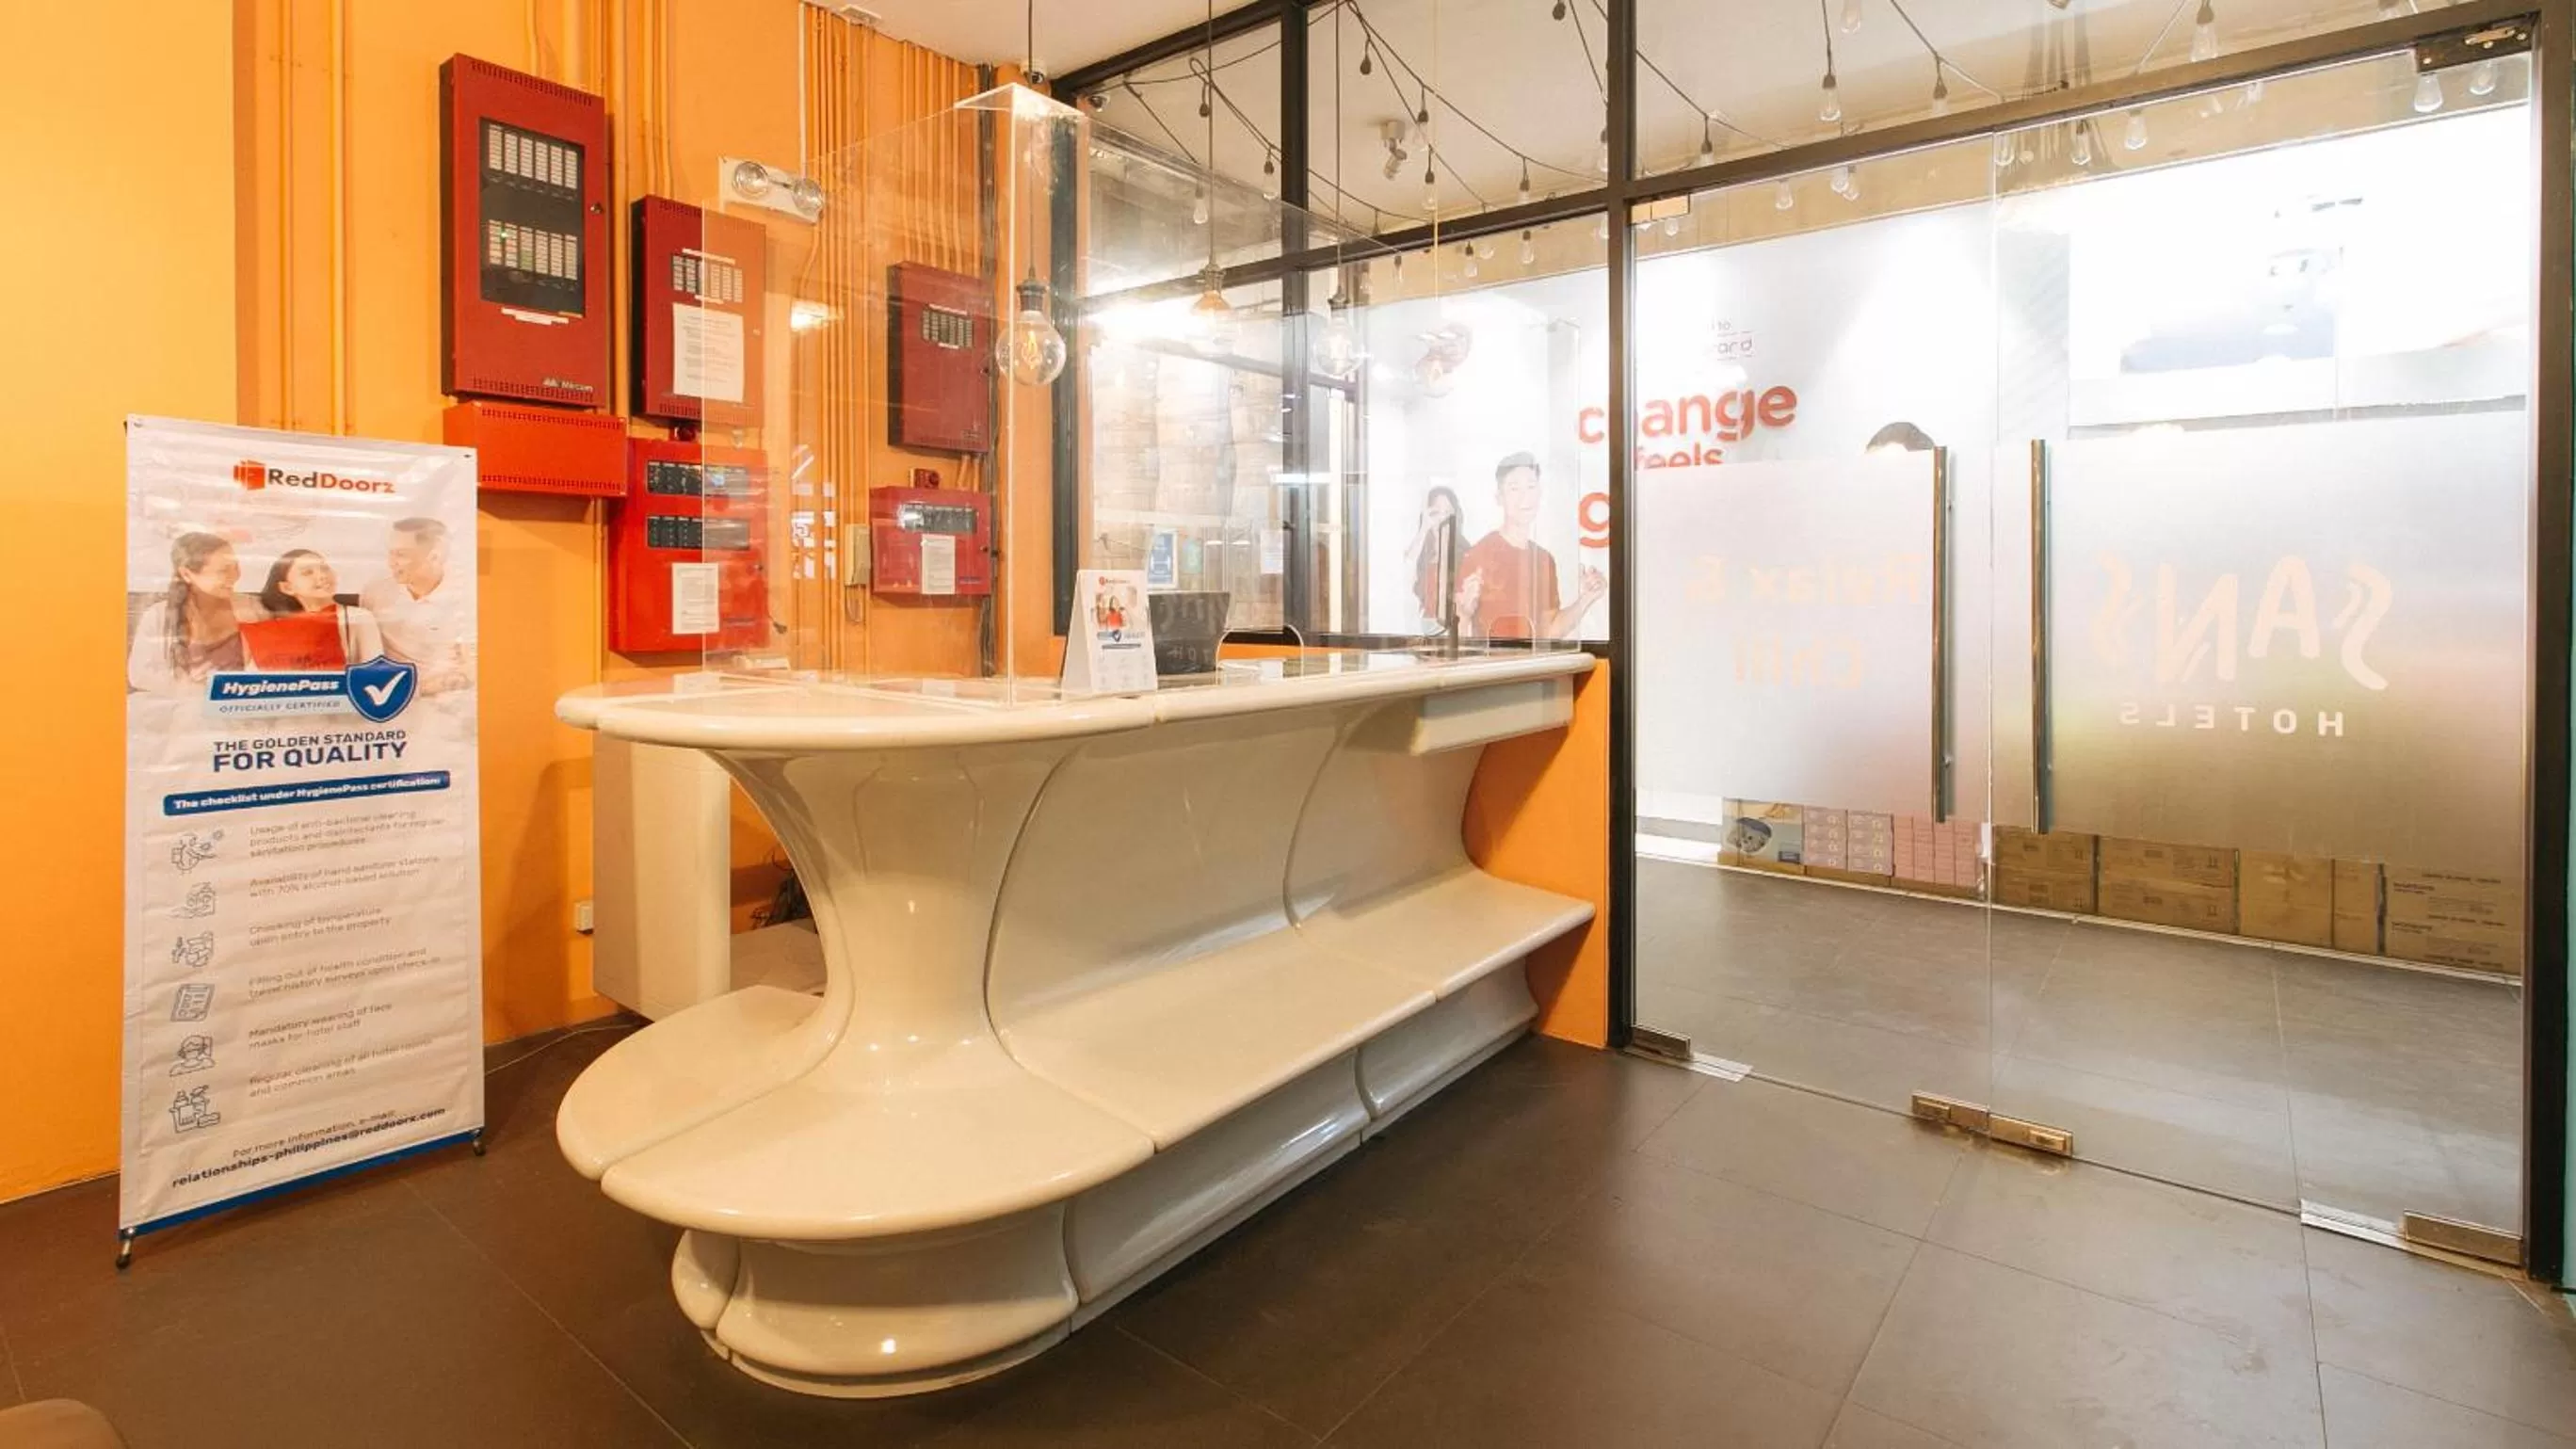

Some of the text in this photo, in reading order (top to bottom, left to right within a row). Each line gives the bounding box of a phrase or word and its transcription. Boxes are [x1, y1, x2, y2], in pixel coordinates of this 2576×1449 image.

[1578, 385, 1797, 443] cange
[267, 467, 396, 494] RedDoorz
[222, 679, 340, 697] HygienePass
[219, 700, 340, 714] OFFICIALLY CERTIFIED
[214, 729, 406, 752] THE GOLDEN STANDARD
[213, 740, 409, 772] FOR QUALITY
[173, 798, 199, 810] The
[201, 792, 257, 807] checklist
[259, 788, 295, 801] under
[296, 782, 368, 798] HygienePass
[171, 1107, 445, 1188] relationships-philippines@reddoorz.com
